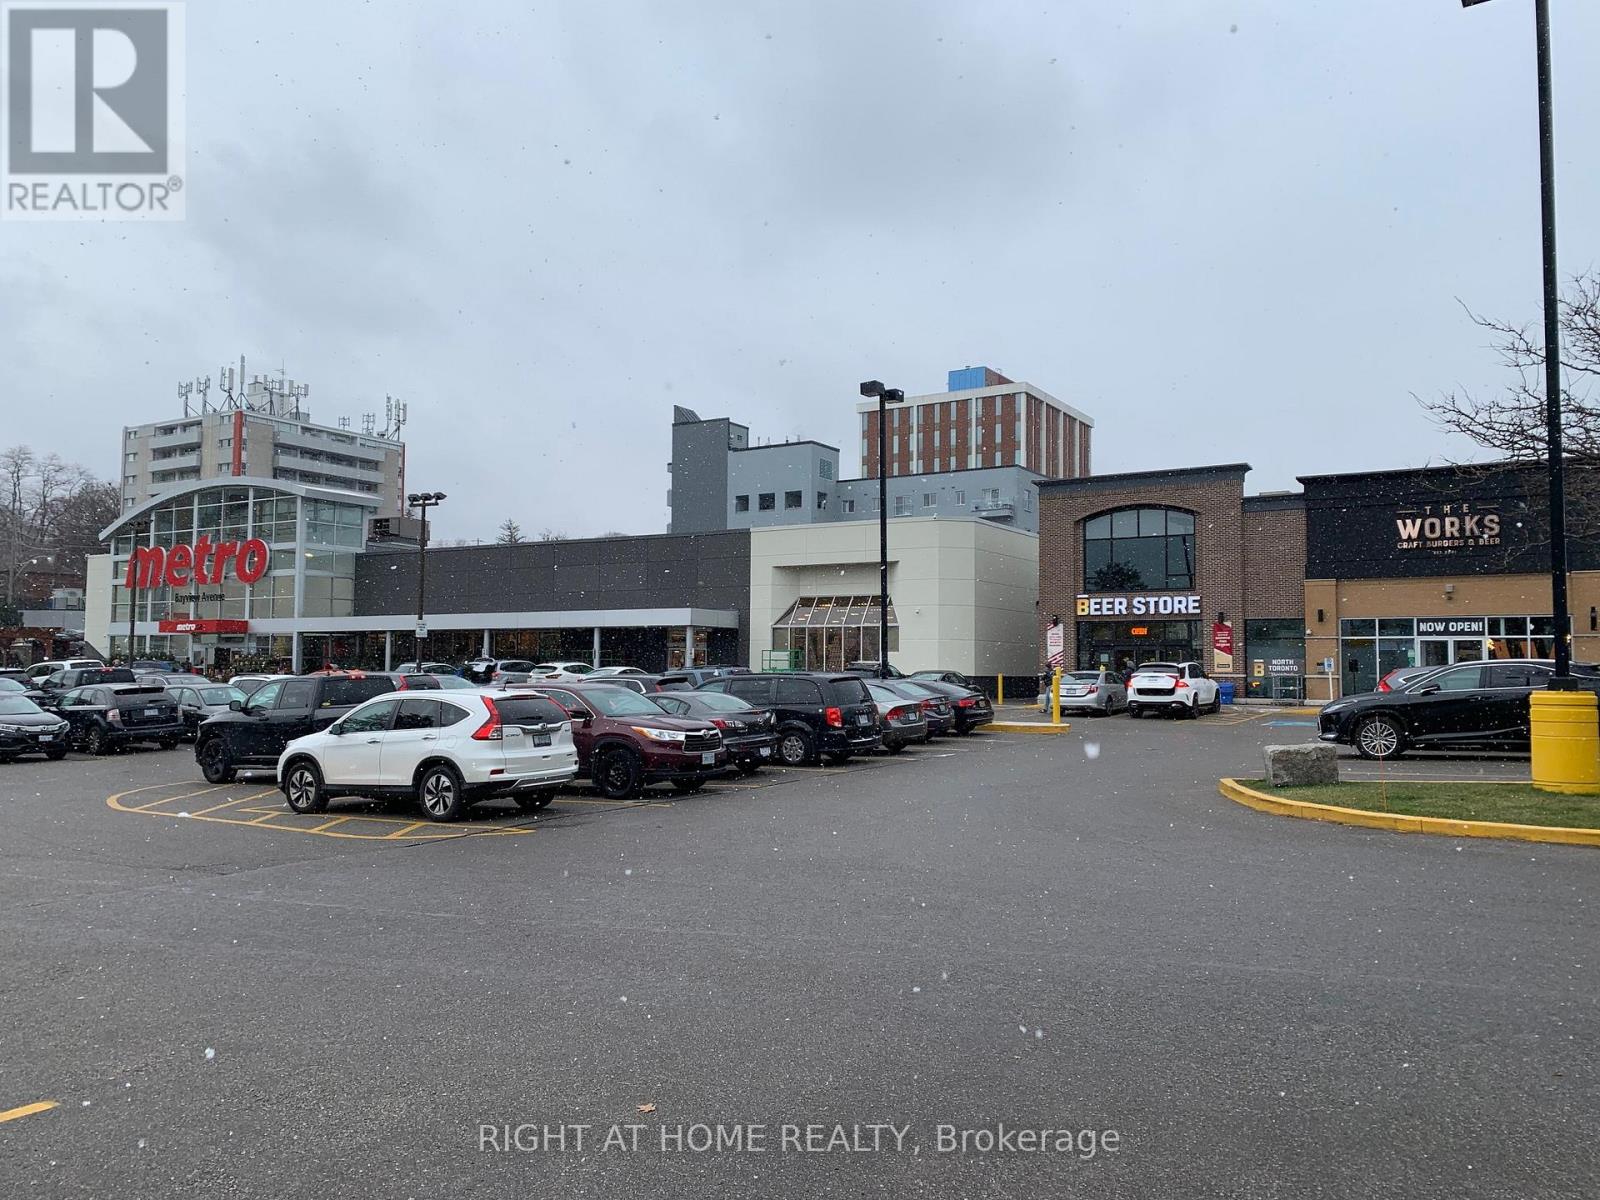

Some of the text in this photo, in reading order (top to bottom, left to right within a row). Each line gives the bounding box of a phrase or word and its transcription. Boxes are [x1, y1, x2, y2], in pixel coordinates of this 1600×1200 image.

[1425, 503, 1470, 515] THE
[1396, 514, 1501, 540] WORKS
[1397, 540, 1422, 549] CRAFT
[1426, 539, 1465, 548] BURGERS
[1479, 537, 1501, 546] BEER
[125, 534, 270, 589] metro
[174, 592, 226, 605] Bayview Avenue
[1076, 594, 1201, 616] BEER STORE
[176, 623, 196, 631] metro
[1419, 621, 1483, 632] NOW OPEN!
